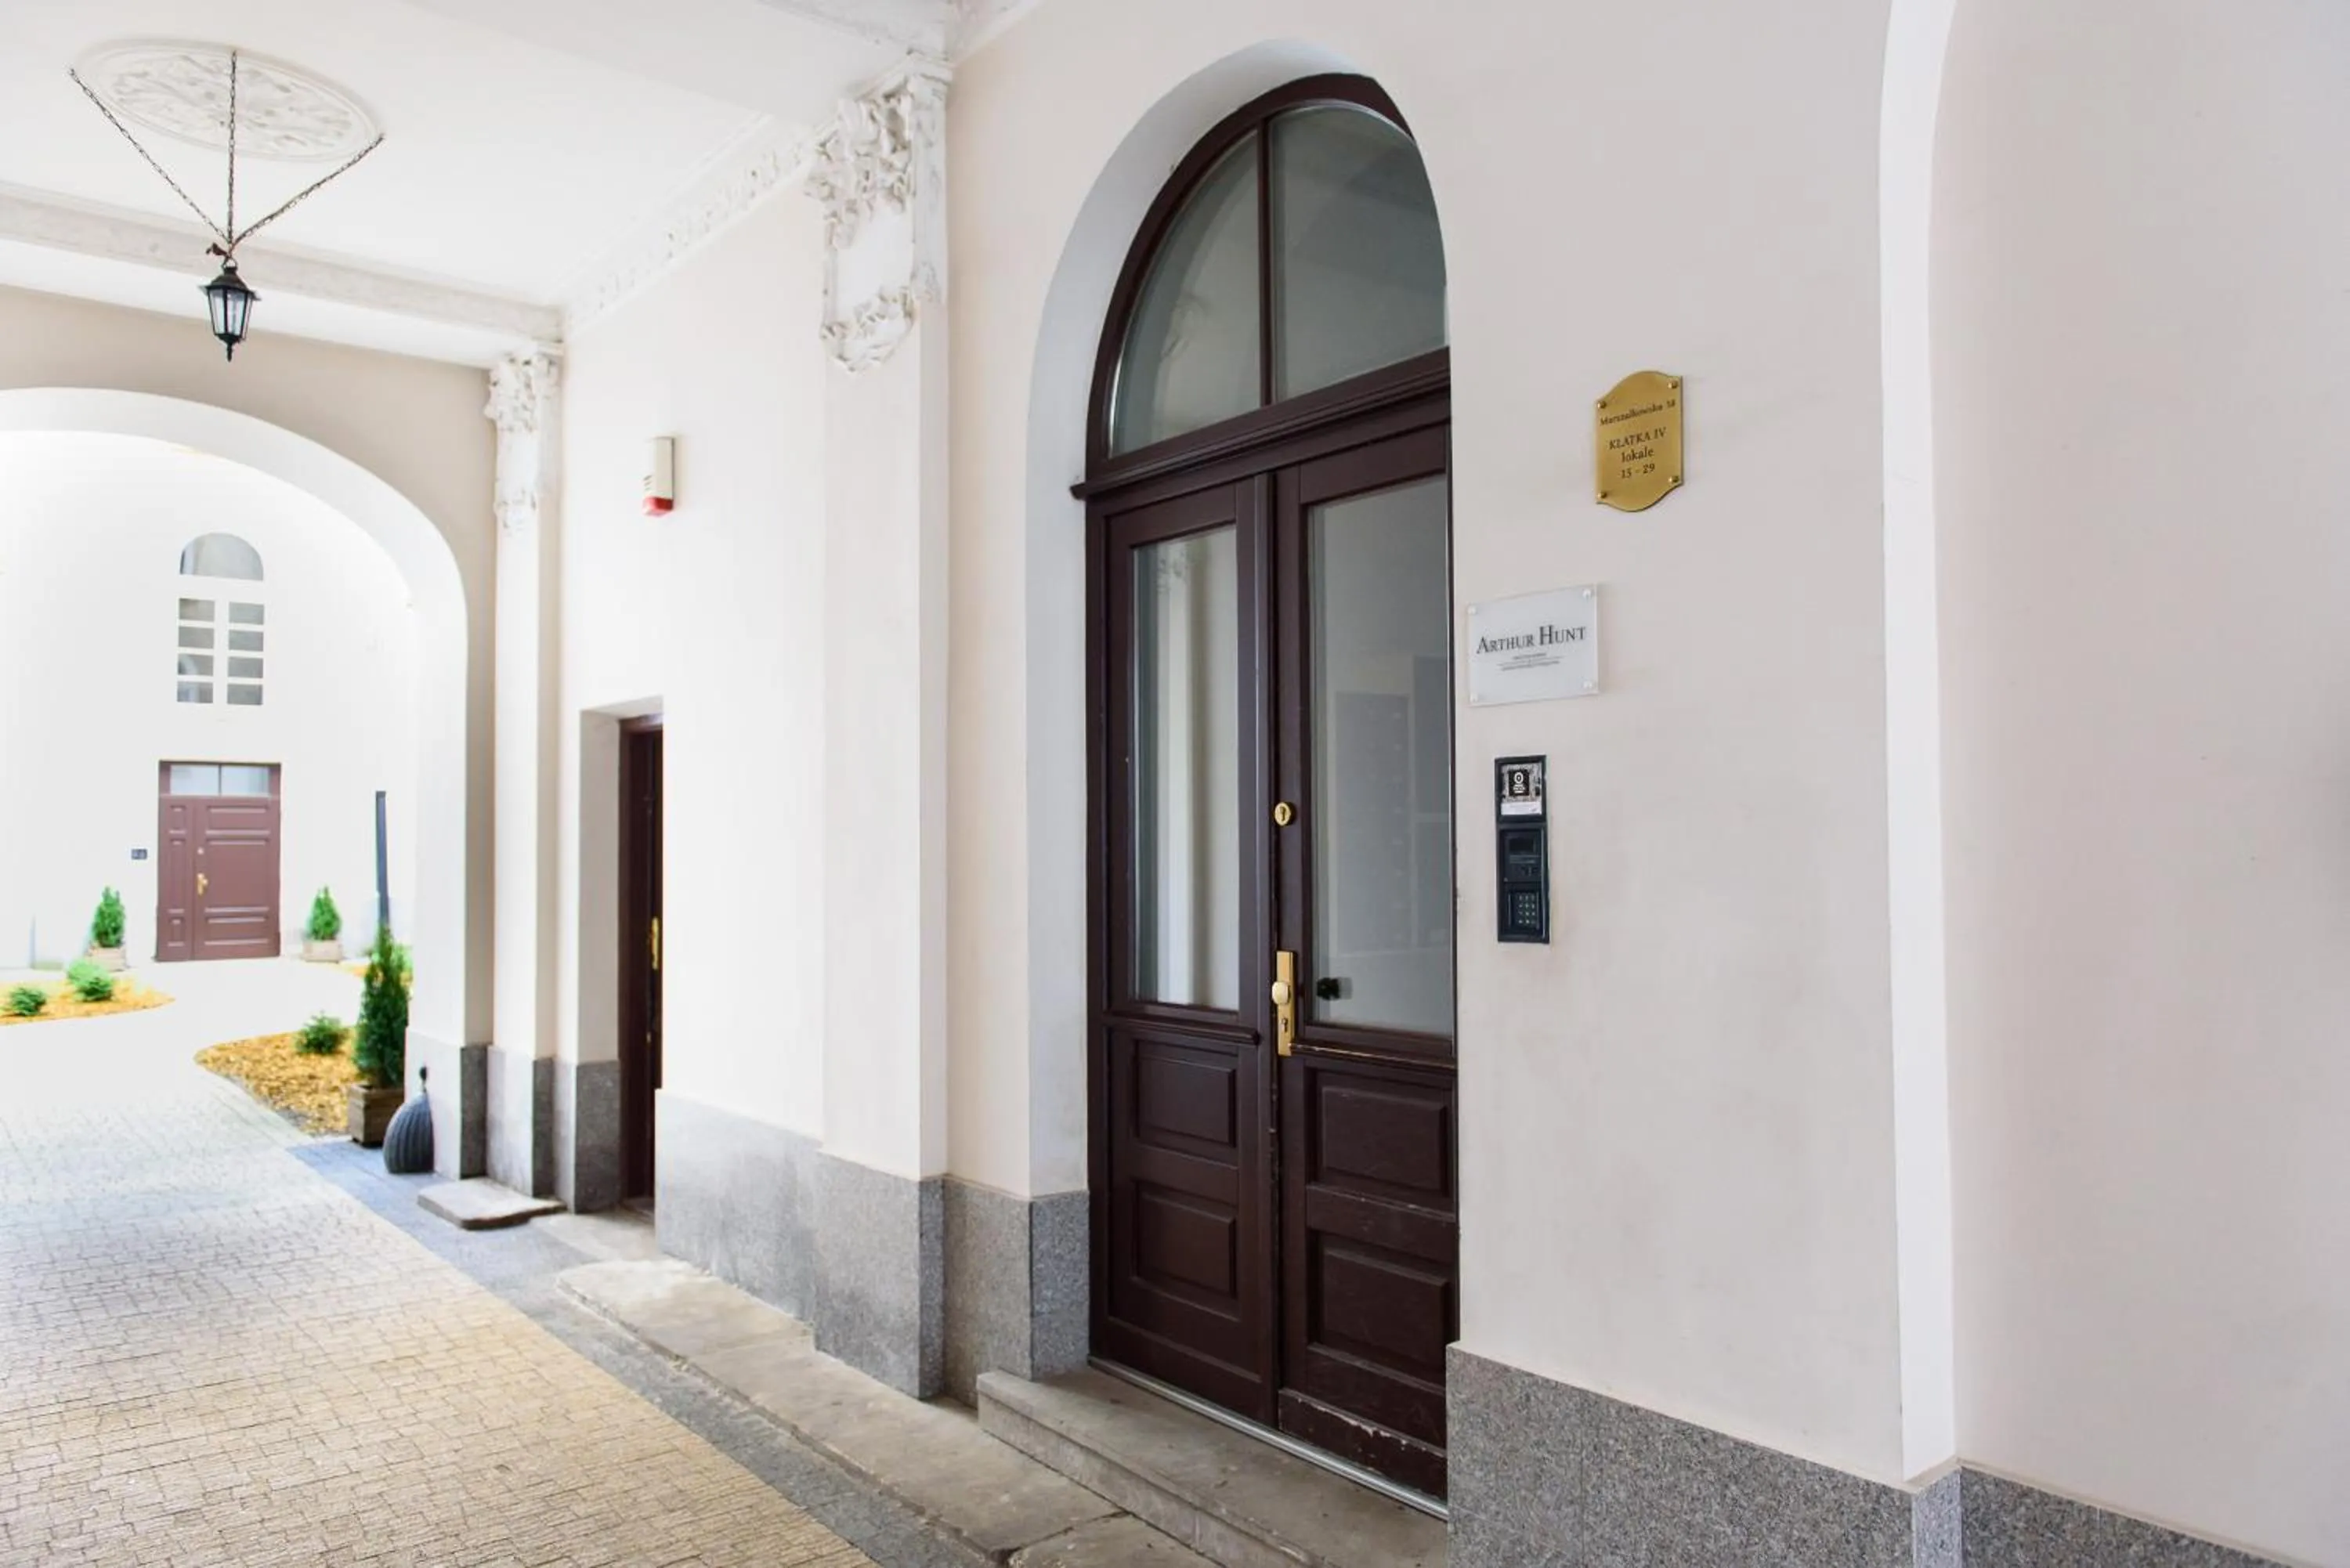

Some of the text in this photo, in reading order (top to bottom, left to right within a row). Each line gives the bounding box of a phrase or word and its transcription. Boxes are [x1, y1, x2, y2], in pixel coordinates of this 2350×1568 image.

[1609, 427, 1666, 450] KLATKA IV
[1622, 446, 1654, 463] lokale
[1643, 463, 1655, 474] 29
[1476, 625, 1586, 654] ARTHUR HUNT
